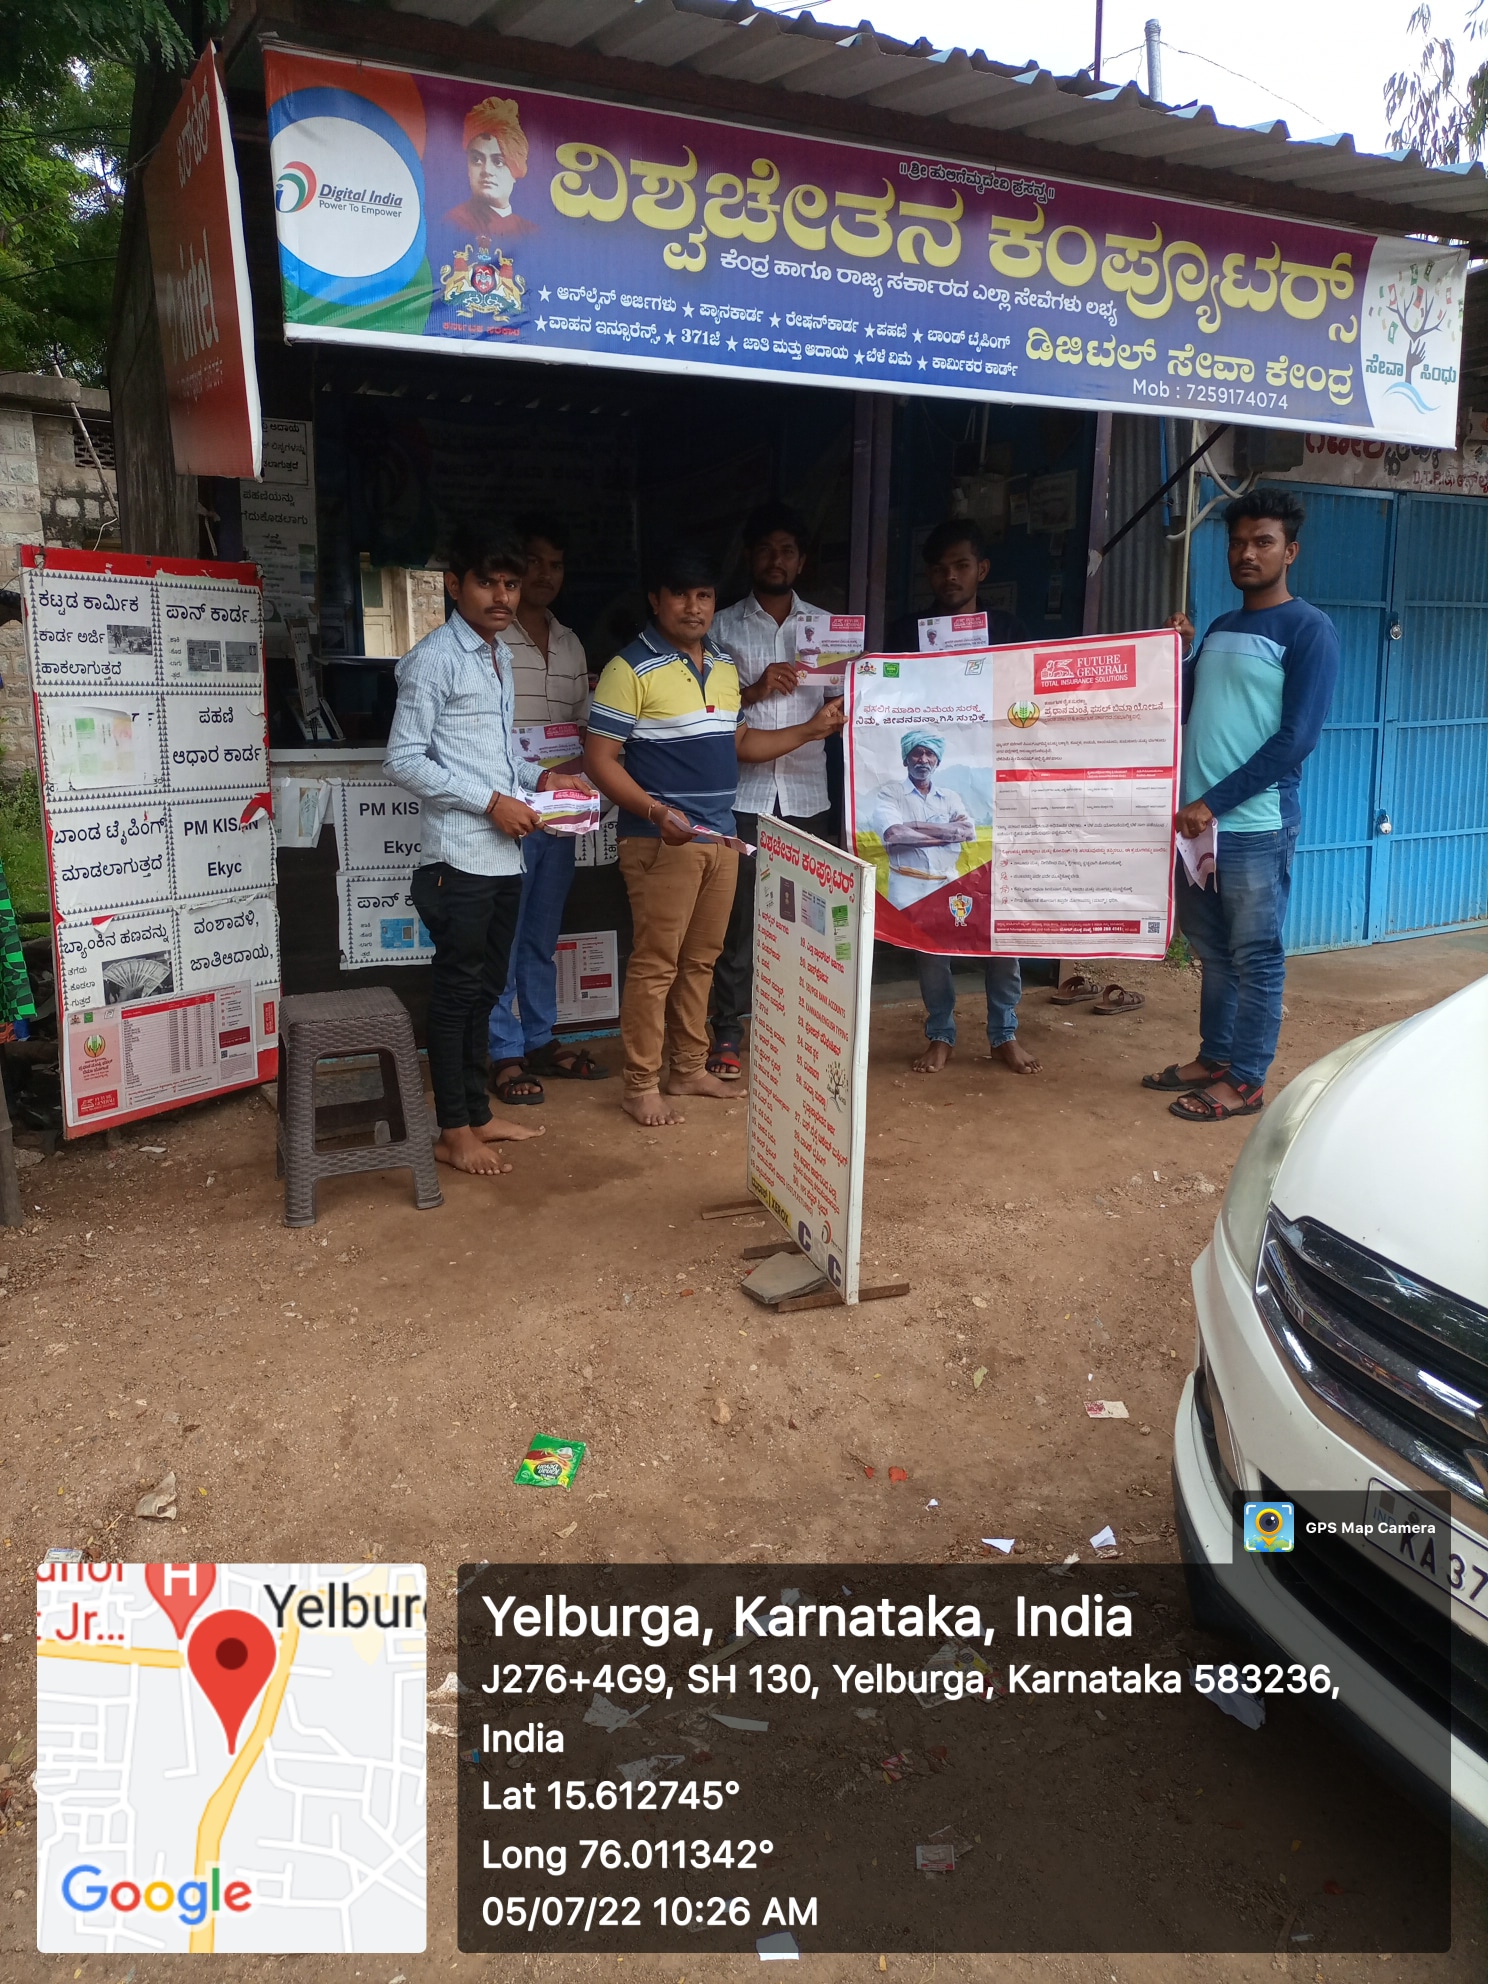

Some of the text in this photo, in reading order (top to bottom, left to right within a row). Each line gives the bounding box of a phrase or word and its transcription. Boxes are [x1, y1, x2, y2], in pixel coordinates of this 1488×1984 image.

[320, 184, 403, 206] Digital India
[320, 200, 402, 217] Power To Empower
[550, 142, 1358, 344] ವಿಶ್ವಚೇತನ ಕಂಪ್ಯೂಟರ್ಸ್
[180, 228, 219, 361] airtel
[774, 260, 832, 281] ಹಾಗೂ
[836, 267, 883, 298] ರಾಜ್ಯ
[887, 272, 969, 298] ಸರ್ಕಾರದ
[973, 285, 1011, 312] ಎಲ್ಲಾ
[1014, 287, 1081, 313] ಸೇವೆಗಳು
[1086, 300, 1118, 327] ಲಭ್ಯ
[549, 315, 592, 332] ವಾಹನ
[743, 337, 769, 352] ಜಾತಿ
[773, 339, 802, 360] ಮತ್ತು
[804, 342, 849, 360] ಆದಾಯ
[888, 351, 912, 366] ವಿಮೆ
[1026, 327, 1354, 406] ಡಿಜಿಟಲ್ ಸೇವಾ ಕೇಂದ್ರ
[1365, 353, 1457, 386] ಸೇವಾ ಸಿಂಧು
[1133, 378, 1170, 398] Mob
[1186, 383, 1288, 410] 7259174074
[39, 590, 139, 616] ಕಟ್ಟಡ ಕಾರ್ಮಿಕ
[166, 603, 206, 620] ಪಾನ್
[39, 630, 73, 643] ಕಾರ್ಡ
[41, 661, 122, 681] ಹಾಕಲಾಗುತ್ತದೆ
[1077, 654, 1121, 668] FUTURE
[1077, 664, 1127, 677] GENERALI
[1061, 677, 1094, 686] INSURANCE
[1095, 674, 1128, 684] SOLUTIONS
[198, 708, 234, 724] ಪಹಣಿ
[172, 745, 219, 767] ಆಧಾರ
[360, 801, 419, 816] PM KIS
[184, 819, 208, 837] PM
[384, 840, 422, 856] Ekyc
[760, 830, 800, 862] ವಿಶ್ವಚೇತನ
[62, 854, 163, 882] ಮಾಡಲಾಗುತ್ತದೆ
[207, 862, 242, 878] Ekyc
[357, 893, 399, 908] ಪಾನ್
[63, 924, 170, 959] ಬ್ಯಾಂಕಿನ ಹಣವನ್ನು
[771, 1196, 788, 1226] XEROX
[1400, 1520, 1488, 1601] KA 37
